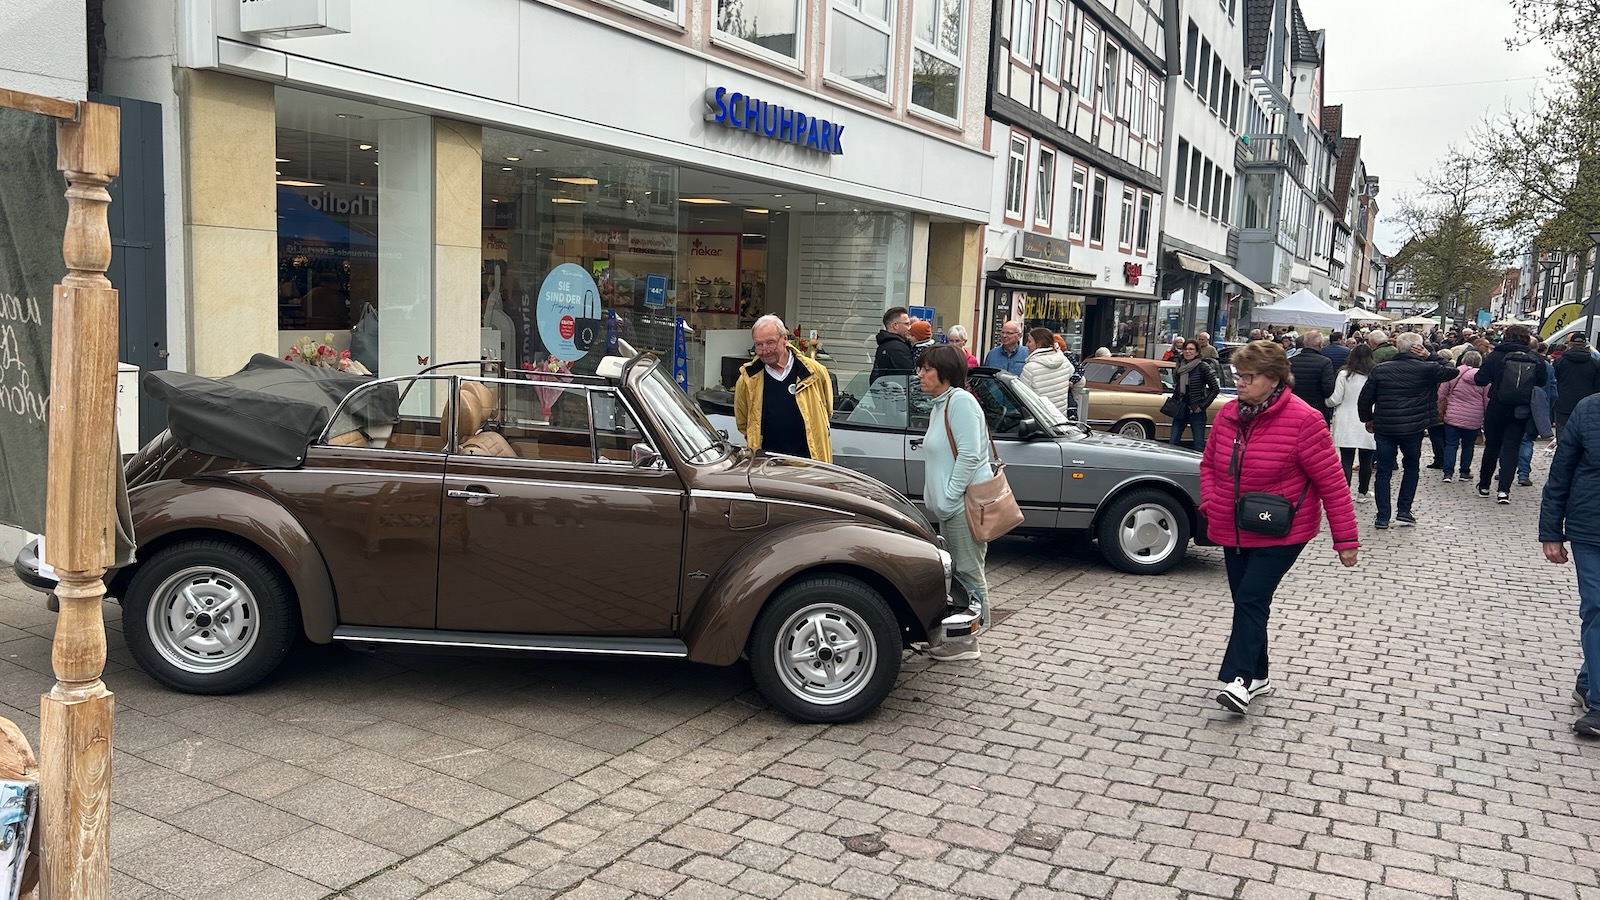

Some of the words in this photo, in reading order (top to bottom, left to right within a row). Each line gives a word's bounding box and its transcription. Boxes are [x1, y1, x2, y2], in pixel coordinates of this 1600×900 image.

[707, 86, 845, 155] SCHUHPARK
[690, 246, 722, 257] rieker
[558, 281, 571, 292] SIE
[545, 291, 565, 304] SIND
[565, 294, 581, 305] DER
[1024, 294, 1057, 320] BEAUTY
[1059, 298, 1082, 320] NAILS
[118, 384, 125, 394] 2
